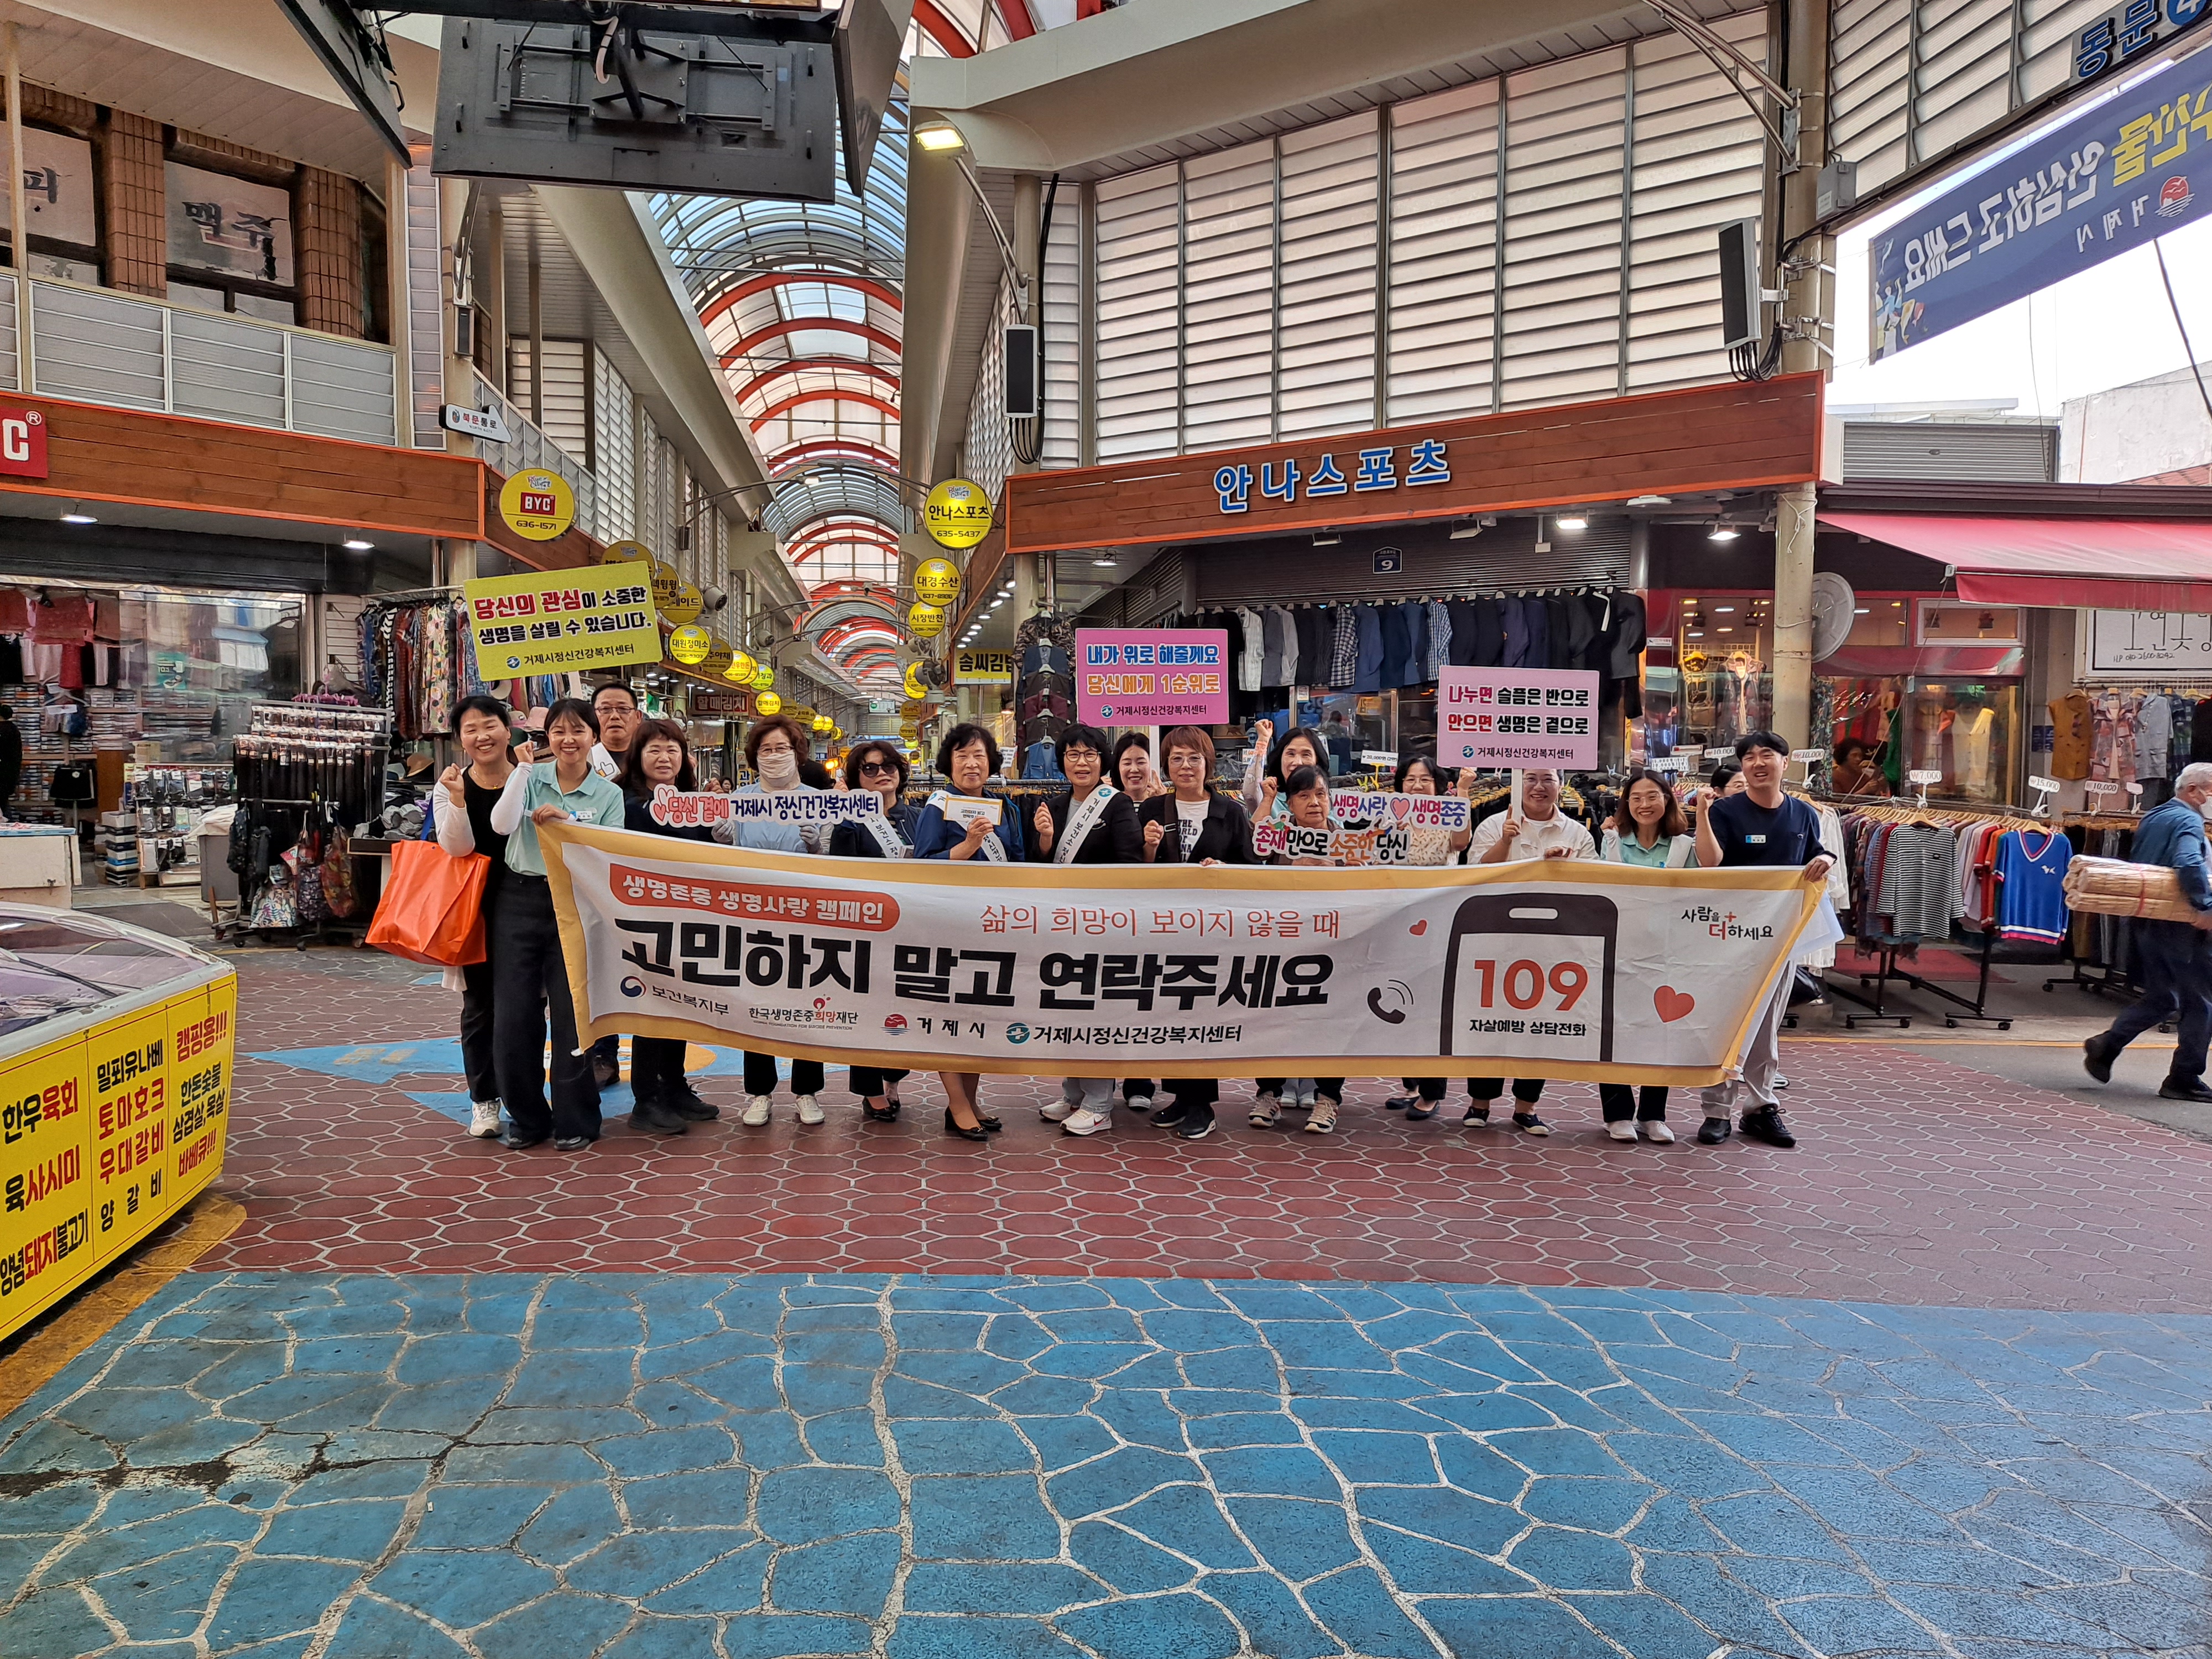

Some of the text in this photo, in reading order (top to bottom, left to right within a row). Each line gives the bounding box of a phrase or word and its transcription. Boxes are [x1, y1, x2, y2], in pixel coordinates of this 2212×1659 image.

[2075, 0, 2159, 79] 동문
[181, 201, 275, 247] 맥주
[1214, 439, 1451, 514] 안나스포츠
[525, 495, 551, 512] BYC
[928, 505, 989, 521] 안나스포츠
[516, 520, 556, 530] 636-1571
[1381, 560, 1394, 571] 9
[917, 576, 959, 588] 대경수산
[473, 586, 646, 620] 당신의 관심이 소중한
[479, 612, 651, 645] 생명을 살릴 수 있습니다.
[911, 614, 943, 623] 시장반찬
[524, 644, 634, 665] 거제시정신건강복지센터
[672, 639, 708, 649] 대원정미소
[1087, 644, 1219, 664] 내가 위로 해줄께요
[1087, 674, 1220, 694] 당신에게 1순위로
[1449, 685, 1589, 707] 나누면 슬픔은 반으로
[697, 696, 745, 711] 할매김치
[1116, 705, 1207, 716] 거제시정신건강복지센터
[1448, 714, 1589, 734] 안으면 생명은 곁으로
[1477, 747, 1573, 760] 거제시정신건강복지센터
[668, 794, 879, 823] 당신 곁에 거제시 정신건강복지센터
[1081, 797, 1100, 822] 거제시
[1333, 794, 1466, 827] 생명사랑 생명존중
[875, 823, 894, 846] 보건소
[1065, 821, 1084, 847] 보건소
[1256, 825, 1407, 861] 존재만으로 소중한 당신
[623, 874, 884, 924] 생명존중 생명사랑 캠페인
[979, 904, 1340, 940] 삶의 희망이 보이지 않을 때
[1681, 906, 1721, 923] 사람을
[1709, 921, 1774, 941] 더하세요
[614, 918, 1335, 1011] 고민하지 말고 연락주세요
[1473, 958, 1589, 1012] 109
[651, 984, 729, 1016] 보건복지부
[748, 1007, 859, 1024] 한국생명존중희망재단
[1469, 1019, 1587, 1037] 자살예방 상담전화
[176, 1010, 228, 1063] 캠핑용!!!
[1033, 1024, 1243, 1045] 거제시정신건강복지센터
[97, 1038, 164, 1094] 밀푀유나베
[2, 1076, 79, 1145] 한우육회
[98, 1077, 165, 1140] 토마호크
[99, 1118, 165, 1185] 우대갈비
[178, 1128, 217, 1178] 바베큐!!!
[4, 1144, 80, 1214] 육사시미
[0, 1207, 89, 1297] 양념돼지불고기
